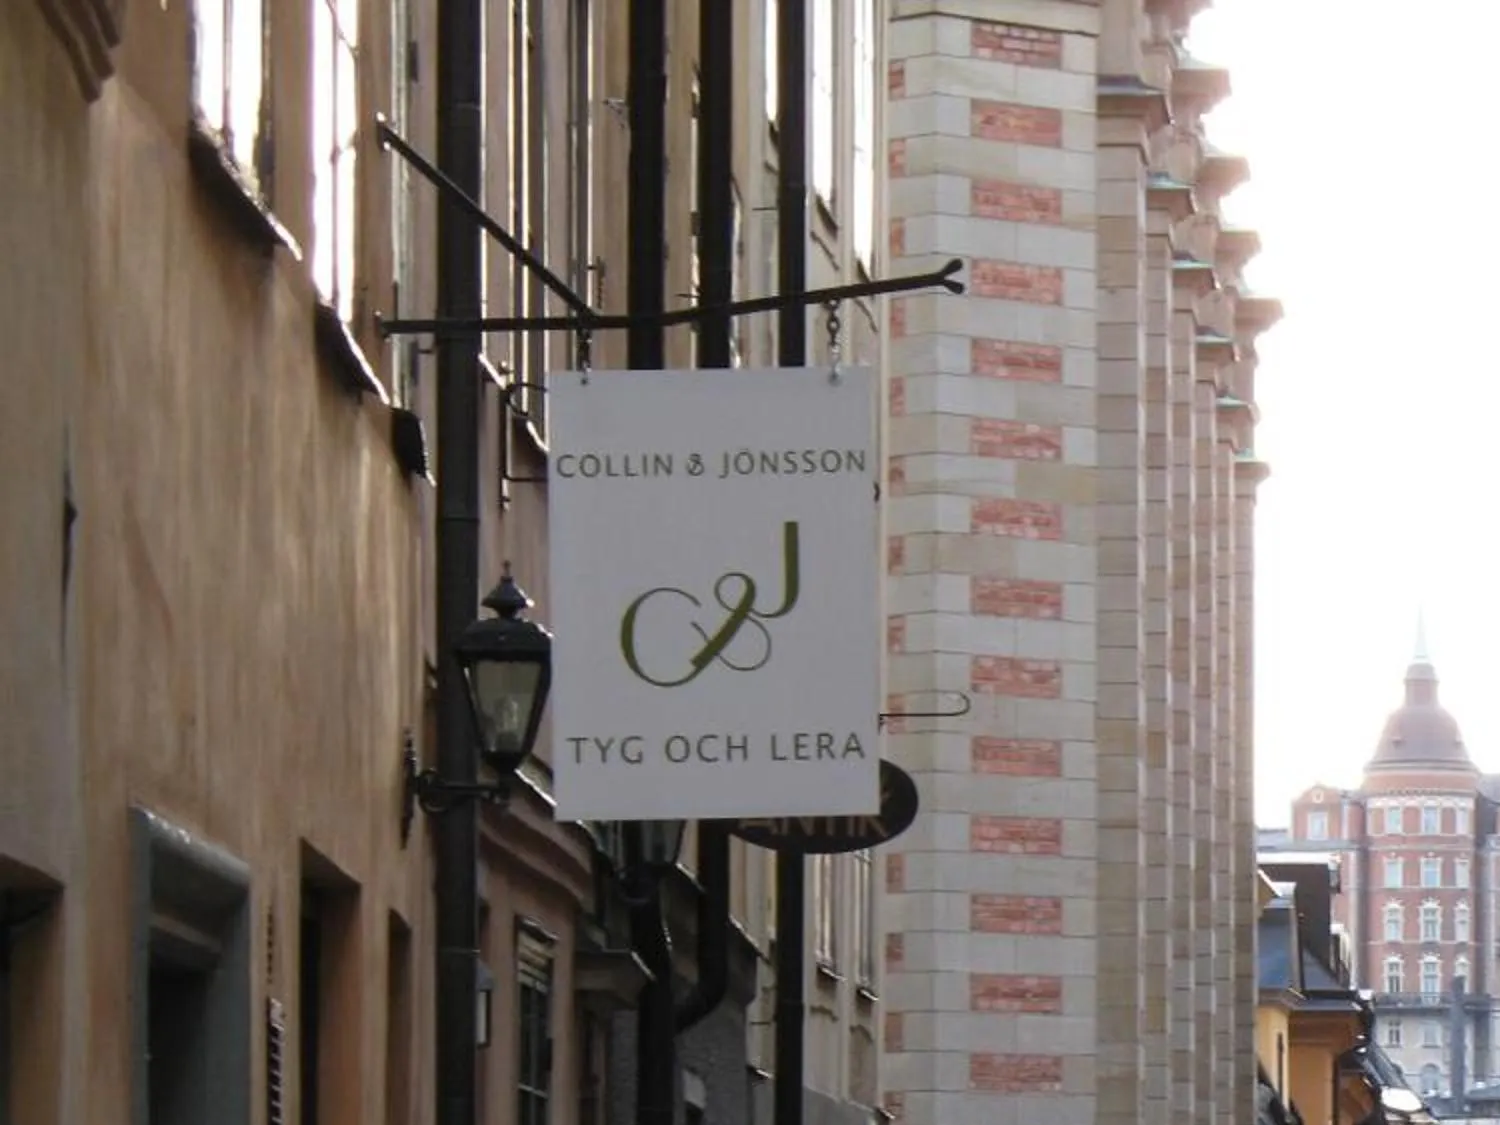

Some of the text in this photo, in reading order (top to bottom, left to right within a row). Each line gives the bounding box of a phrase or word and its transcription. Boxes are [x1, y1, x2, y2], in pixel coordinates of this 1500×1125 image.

[556, 453, 673, 478] COLLIN
[685, 453, 706, 477] &
[565, 731, 866, 765] TYG OCH LERA
